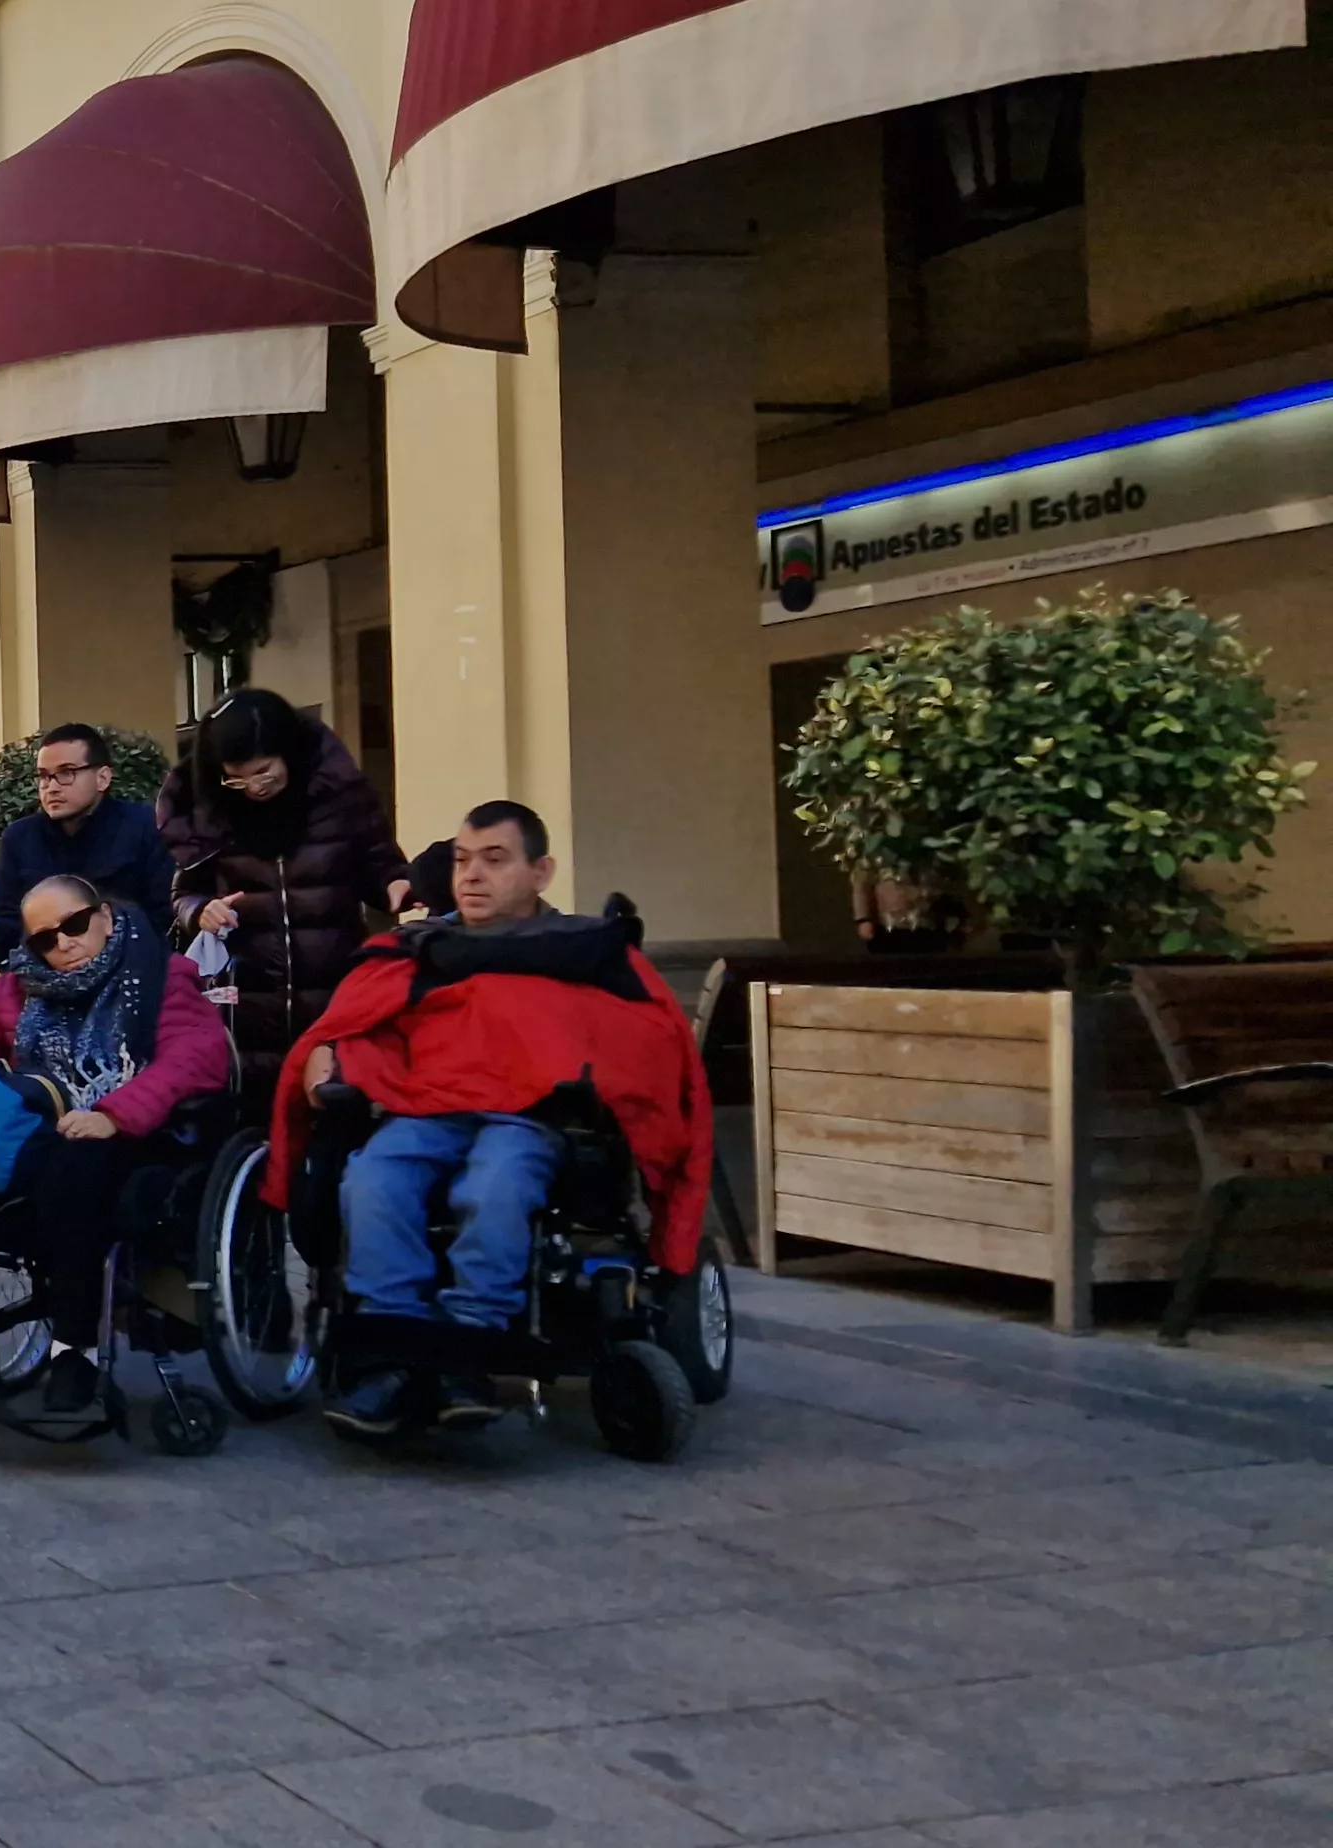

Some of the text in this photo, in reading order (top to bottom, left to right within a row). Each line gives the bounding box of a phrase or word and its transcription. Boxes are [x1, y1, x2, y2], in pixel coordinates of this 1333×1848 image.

[831, 477, 1146, 573] Apuestas del Estado
